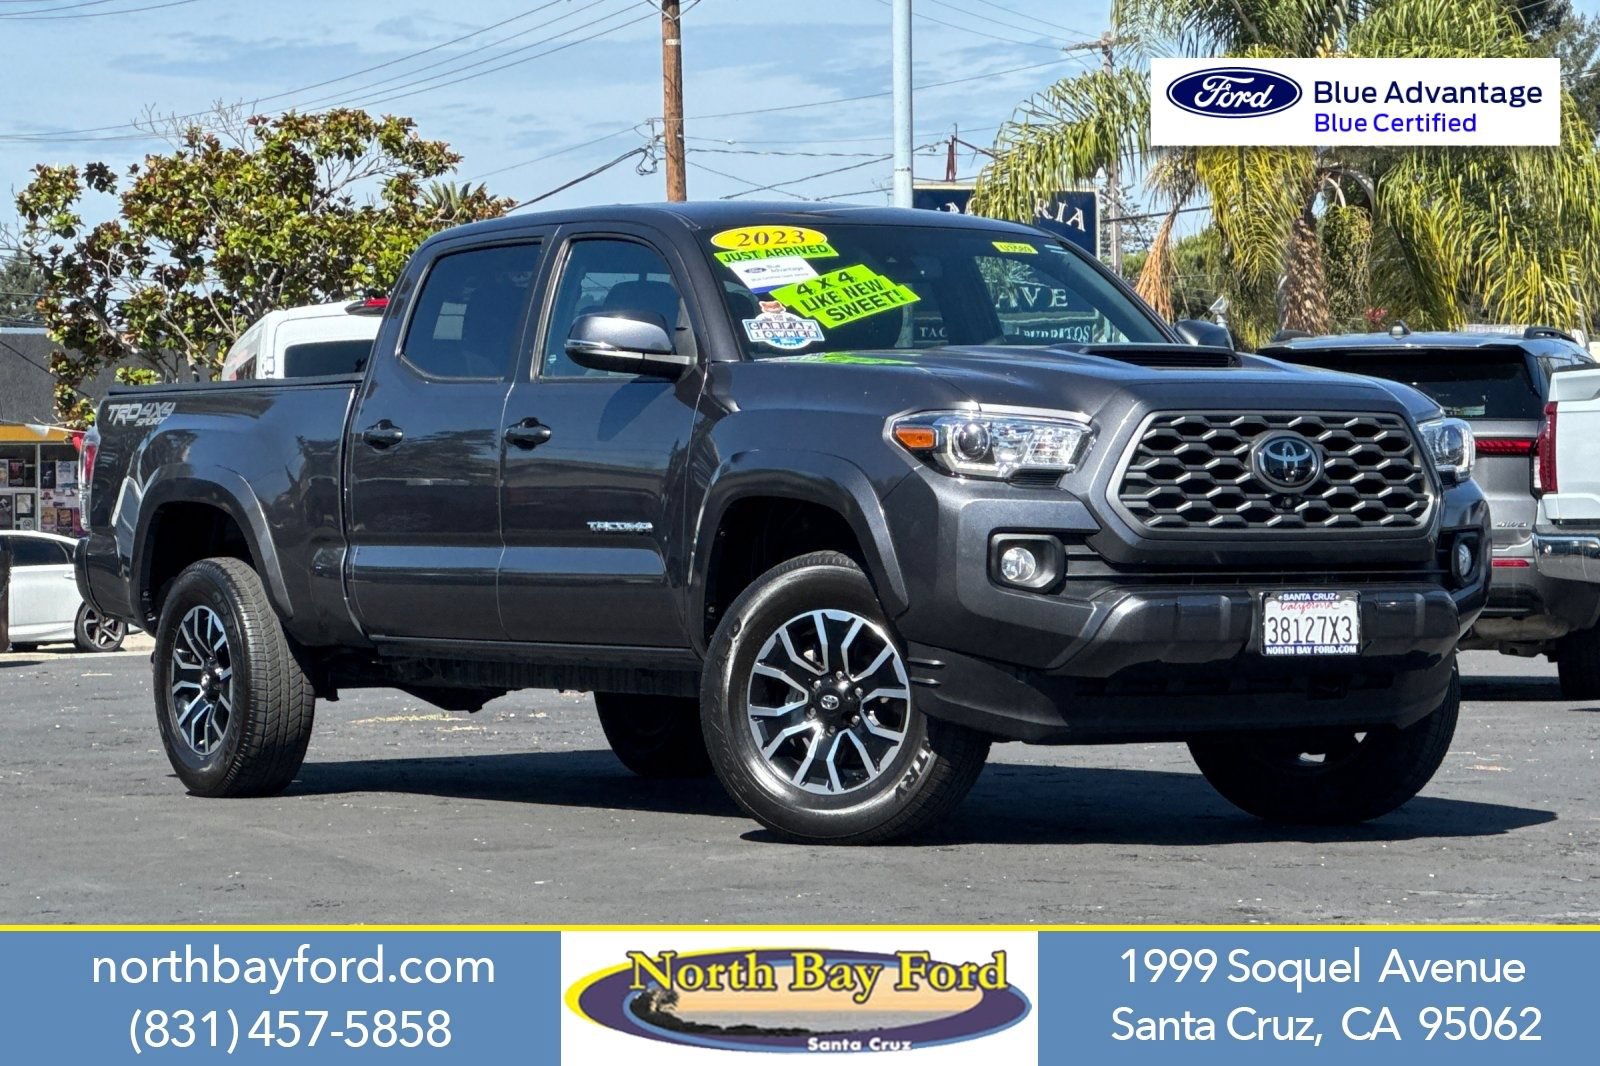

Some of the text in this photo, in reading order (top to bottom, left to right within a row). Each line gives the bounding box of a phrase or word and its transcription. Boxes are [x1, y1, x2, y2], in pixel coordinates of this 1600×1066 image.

[736, 230, 806, 247] 2023
[724, 245, 829, 262] JUST ARRIVED
[796, 283, 814, 295] 4
[838, 270, 856, 283] 4
[800, 278, 884, 312] LIKE NEW
[825, 288, 904, 321] SWEET!
[108, 404, 143, 426] TRD
[586, 521, 654, 532] TACOMA
[1283, 592, 1336, 601] SANTA CRUZ
[1267, 615, 1353, 644] 38127X3
[1296, 646, 1312, 655] BAY
[1313, 645, 1357, 654] FORD.COM
